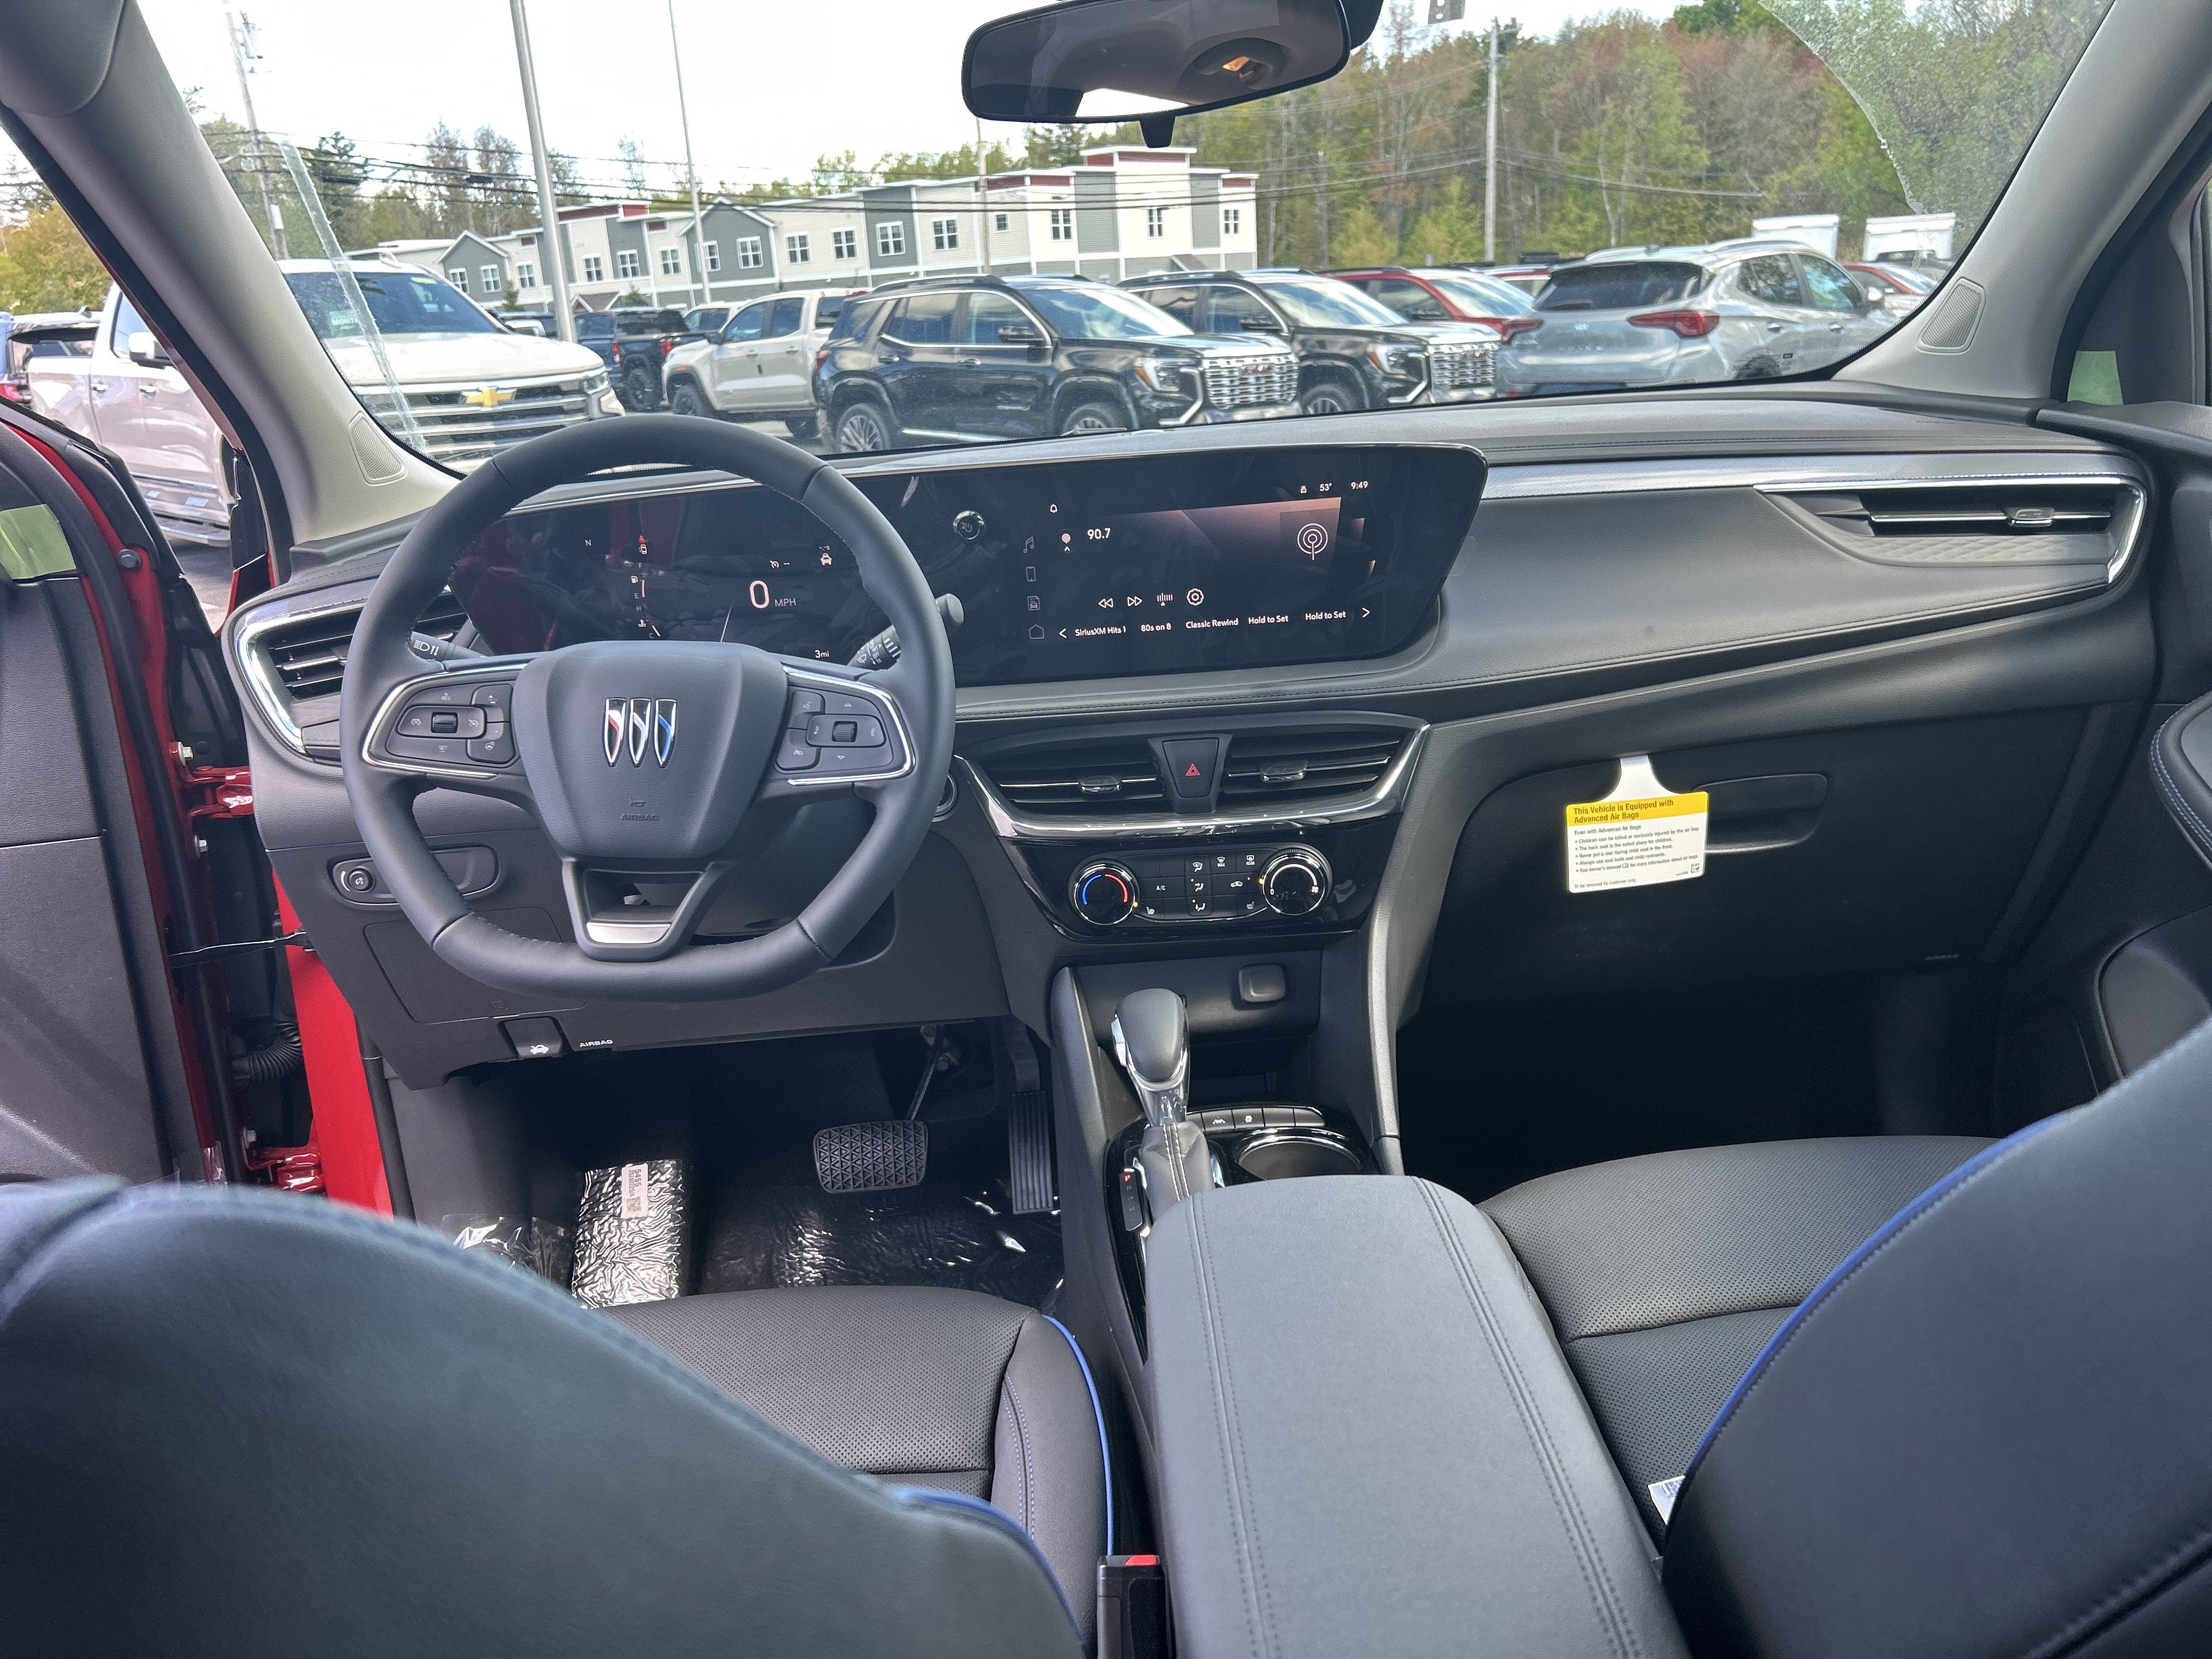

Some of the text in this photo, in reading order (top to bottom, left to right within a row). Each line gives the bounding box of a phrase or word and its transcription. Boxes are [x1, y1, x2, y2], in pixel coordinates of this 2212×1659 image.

[1319, 483, 1331, 492] 53°
[1351, 481, 1368, 489] 9:49
[1087, 528, 1111, 540] 90.7
[749, 580, 797, 608] 0 MPH
[1248, 616, 1266, 624] Hold
[1305, 612, 1323, 620] Hold
[1141, 624, 1154, 632] 80s
[1186, 618, 1239, 629] Classic Rewind
[1075, 627, 1106, 636] SiriusXM
[1108, 626, 1122, 634] Hits
[1626, 801, 1657, 810] Equipped
[1575, 814, 1608, 823] Advanced
[580, 1040, 613, 1048] AIRBAG
